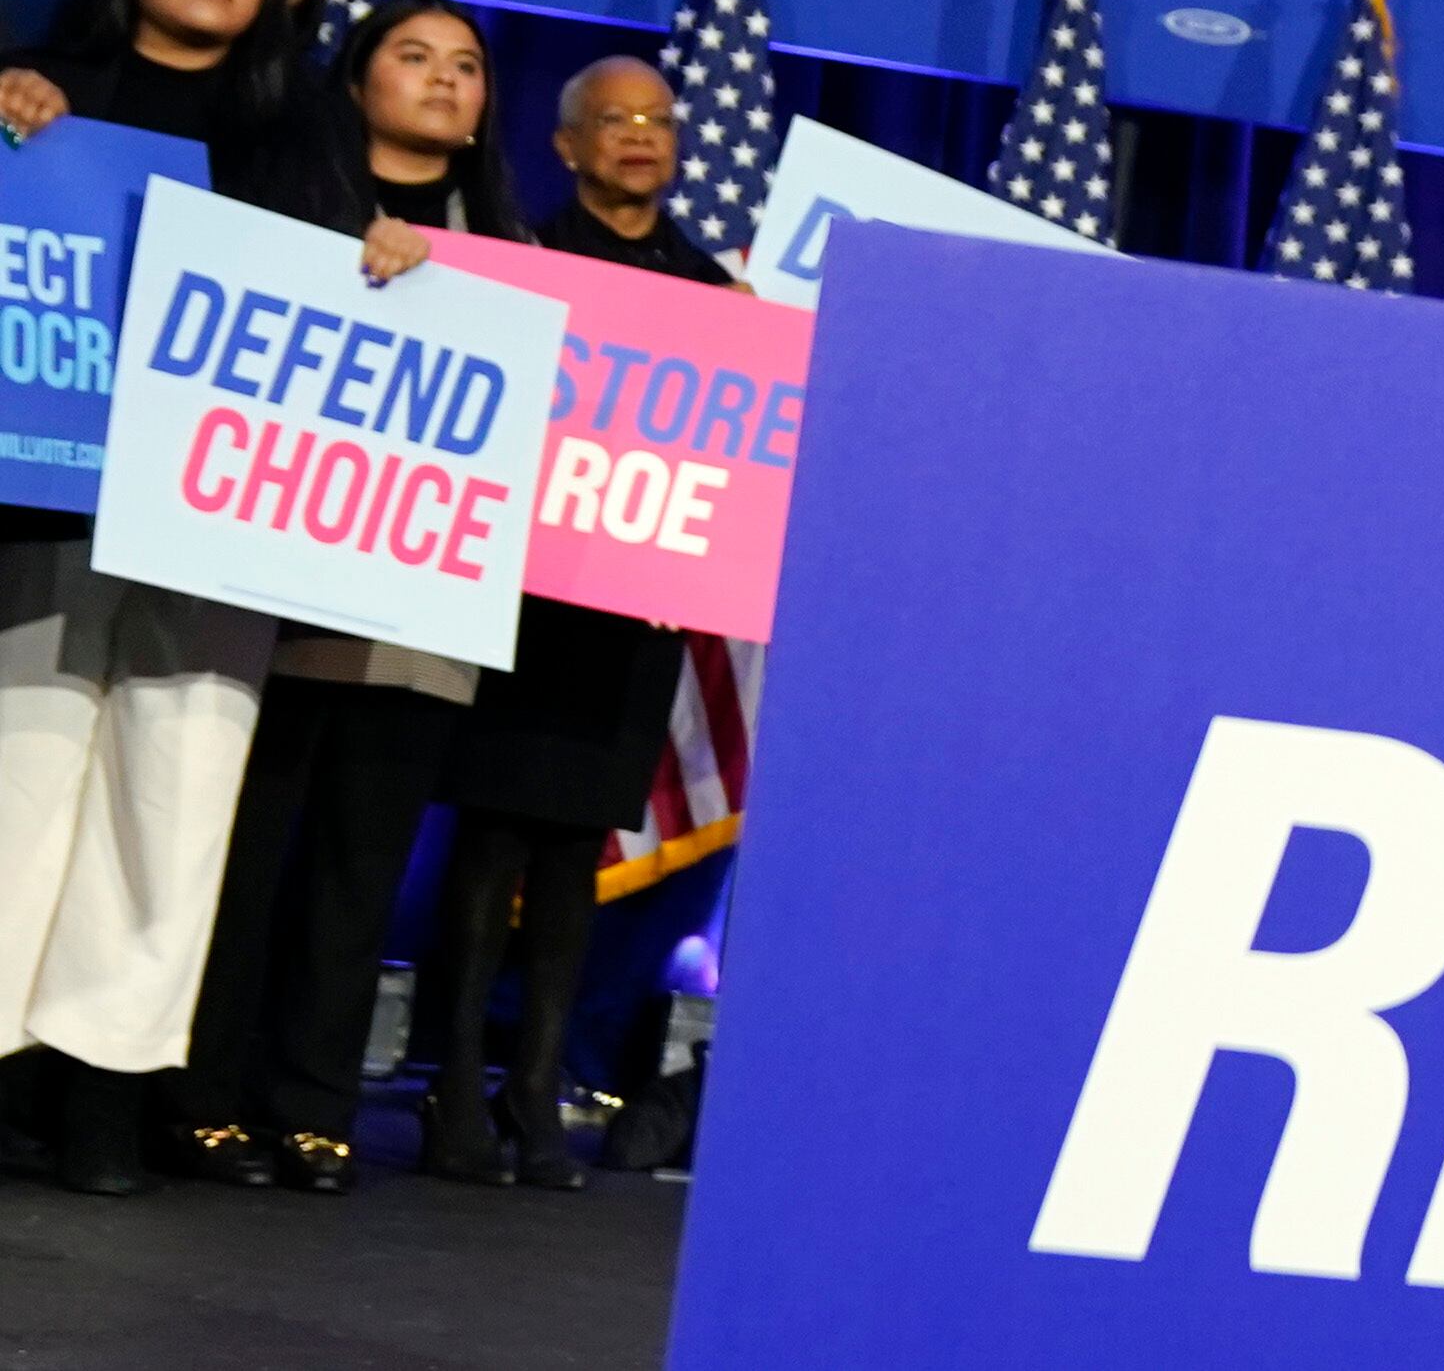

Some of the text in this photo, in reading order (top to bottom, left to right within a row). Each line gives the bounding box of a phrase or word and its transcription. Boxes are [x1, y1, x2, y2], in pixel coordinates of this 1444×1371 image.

[0, 223, 105, 310] ECT
[0, 305, 114, 395] OCR
[148, 270, 506, 457] DEFEND
[181, 406, 510, 582] CHOICE
[538, 436, 730, 557] ROE
